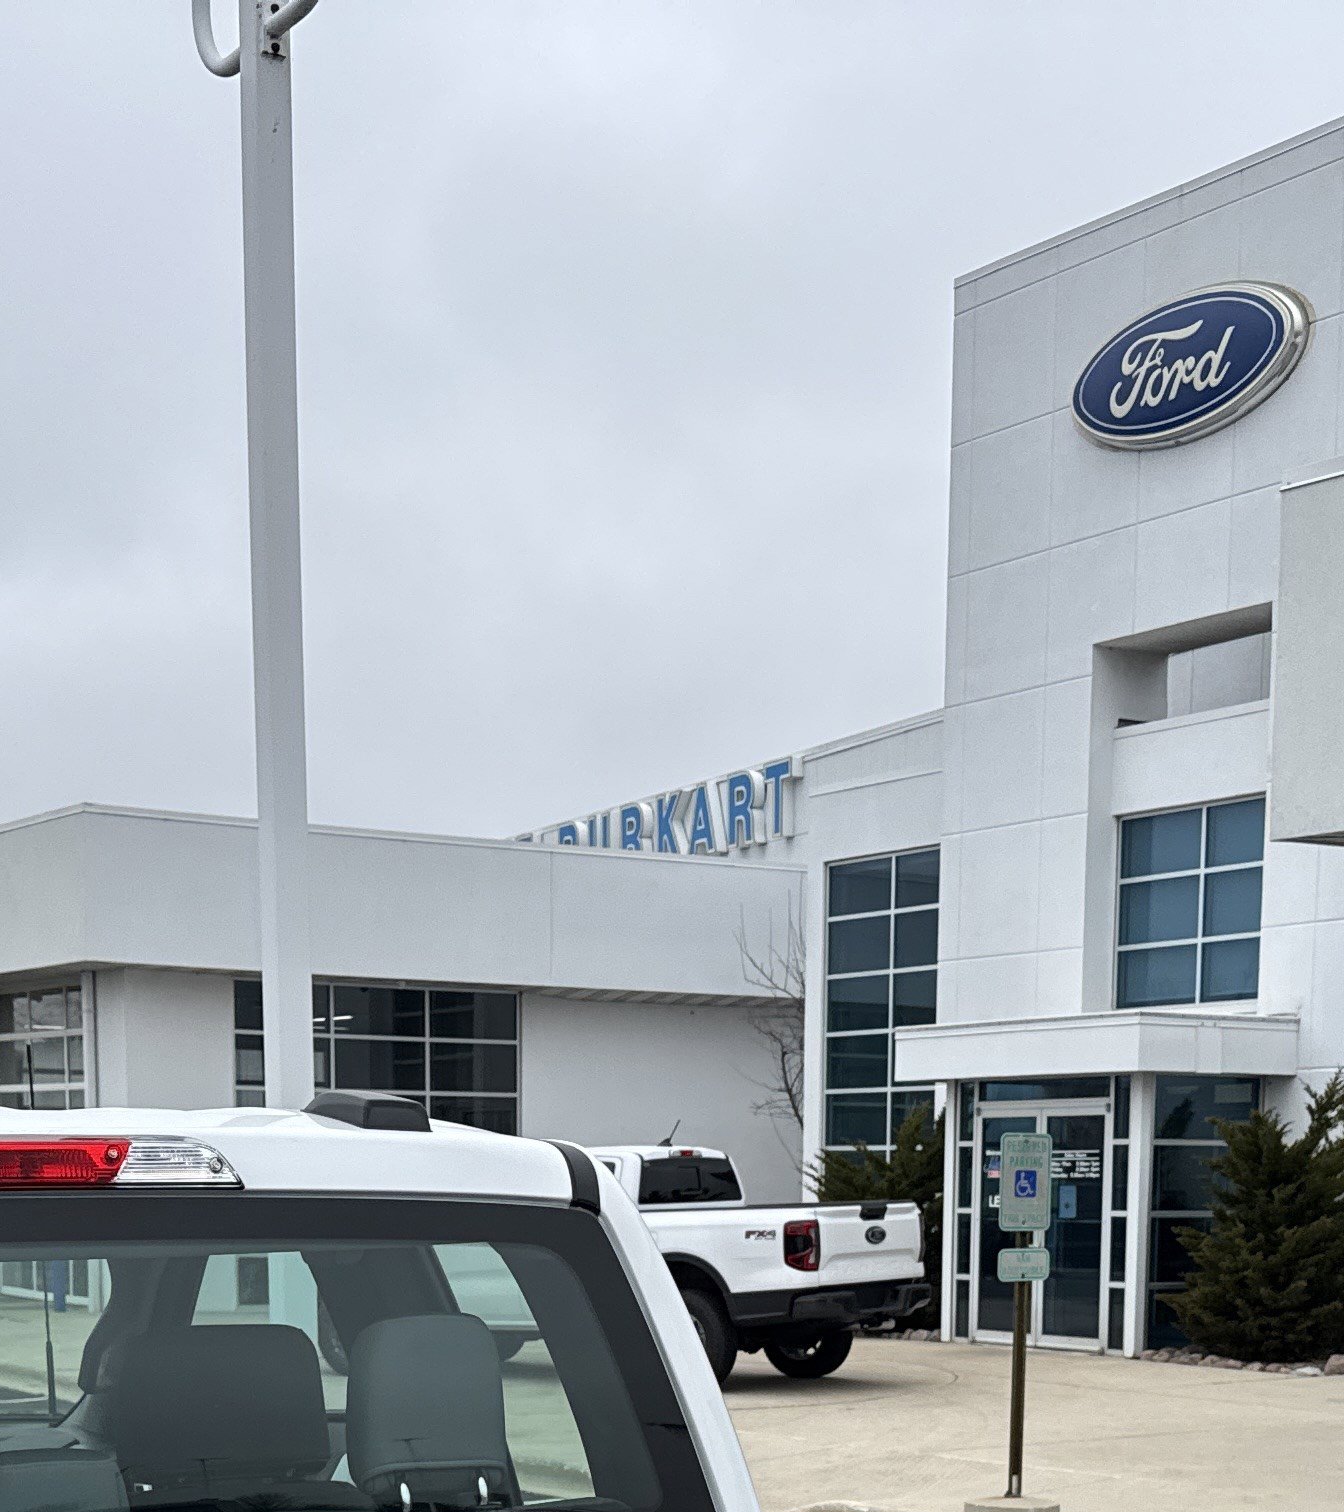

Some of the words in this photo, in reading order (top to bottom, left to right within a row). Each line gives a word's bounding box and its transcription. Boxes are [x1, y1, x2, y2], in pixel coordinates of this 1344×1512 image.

[1109, 319, 1236, 419] Ford
[1009, 1156, 1044, 1169] PARKING
[744, 1229, 777, 1240] FX4
